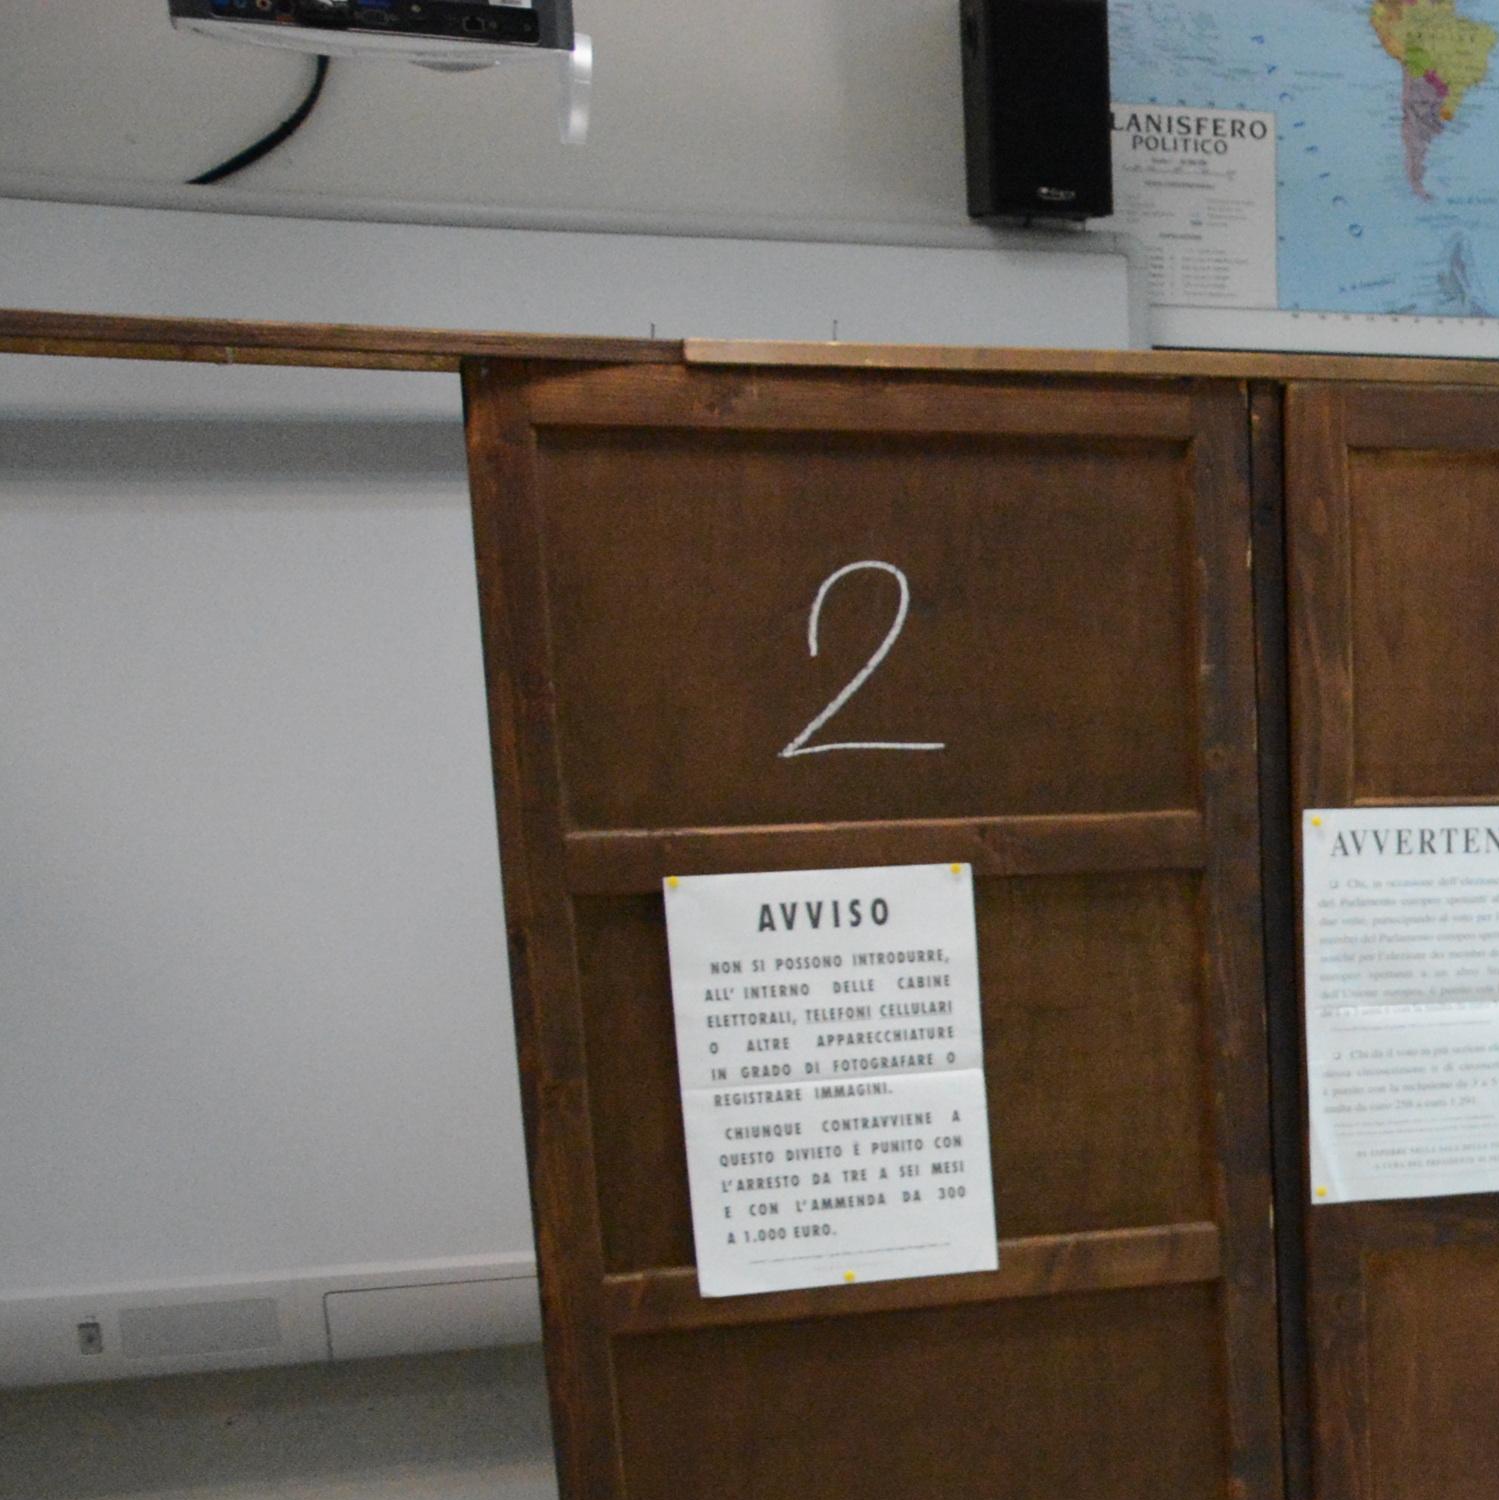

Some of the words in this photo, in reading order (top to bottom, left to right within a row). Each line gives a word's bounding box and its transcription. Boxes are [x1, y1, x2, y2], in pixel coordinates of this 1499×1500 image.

[1111, 112, 1268, 140] LANISFERO
[1132, 134, 1228, 155] POLITICO
[782, 561, 944, 758] 2
[757, 896, 889, 932] AVVISO
[709, 960, 742, 974] NON
[751, 958, 765, 972] SI
[774, 954, 842, 971] POSSONO
[851, 948, 949, 966] INTRODURRE,
[832, 978, 874, 994] DELLE
[896, 973, 950, 990] CABINE
[706, 1010, 796, 1028] ELETTORALI,
[805, 1005, 871, 1022] TELEFONI
[878, 1000, 952, 1018] CELLULARI
[708, 1041, 719, 1055] O
[745, 1036, 789, 1052] ALTRE
[816, 1025, 954, 1047] APPARECCHIATURE
[710, 1068, 727, 1080] IN
[740, 1063, 791, 1079] GRADO
[804, 1061, 819, 1074] DI
[832, 1052, 933, 1072] FOTOGRAFARE
[945, 1050, 956, 1064] O
[713, 1087, 802, 1107] REGISTRARE
[813, 1082, 893, 1099] IMMAGINI.
[724, 1121, 801, 1140] CHIUNQUE
[821, 1111, 932, 1133] CONTRAVVIENE
[951, 1109, 961, 1122] A
[718, 1150, 774, 1167] QUESTO
[784, 1144, 842, 1162] DIVIETO
[870, 1137, 924, 1154] PUNITO
[933, 1134, 962, 1149] CON
[811, 1171, 831, 1186] DA
[841, 1168, 867, 1182] TRE
[878, 1166, 888, 1179] A
[898, 1164, 919, 1178] SEI
[930, 1160, 964, 1175] MESI
[723, 1205, 731, 1219] E
[748, 1202, 779, 1216] CON
[901, 1189, 921, 1203] DA
[937, 1184, 966, 1200] 300
[726, 1231, 736, 1244] A
[743, 1226, 787, 1243] 1.000
[792, 1222, 836, 1239] EURO.
